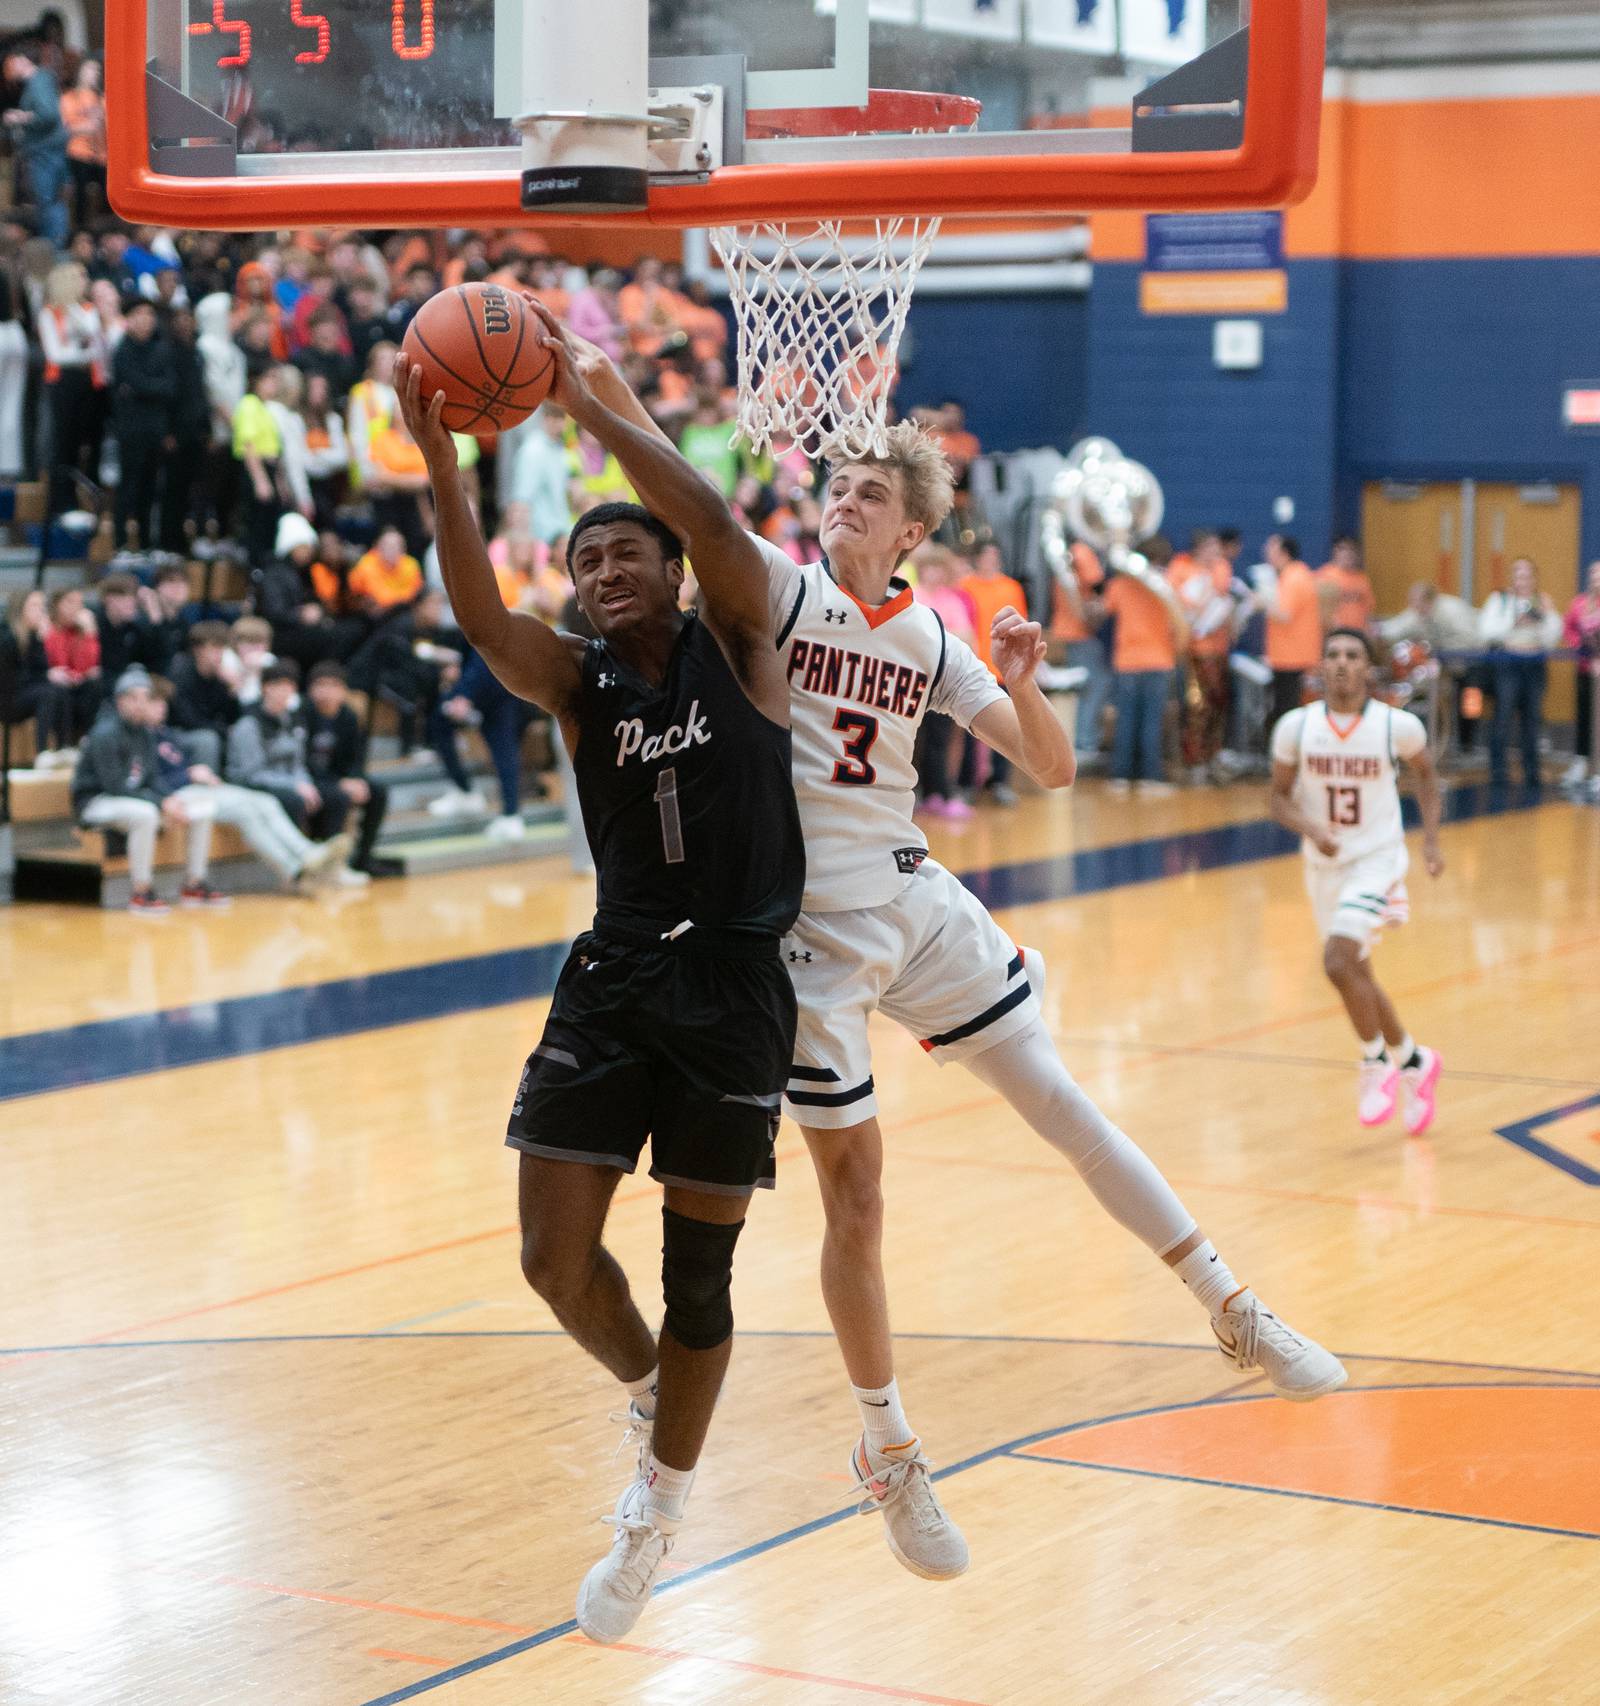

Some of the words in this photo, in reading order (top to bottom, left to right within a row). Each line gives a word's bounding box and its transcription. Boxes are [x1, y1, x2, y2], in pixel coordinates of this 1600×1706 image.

[786, 638, 929, 720] PANTHERS
[614, 699, 712, 767] Pack
[830, 706, 880, 785] 3
[1306, 753, 1380, 778] PANTHERS
[653, 766, 685, 864] 1
[1325, 784, 1361, 827] 13
